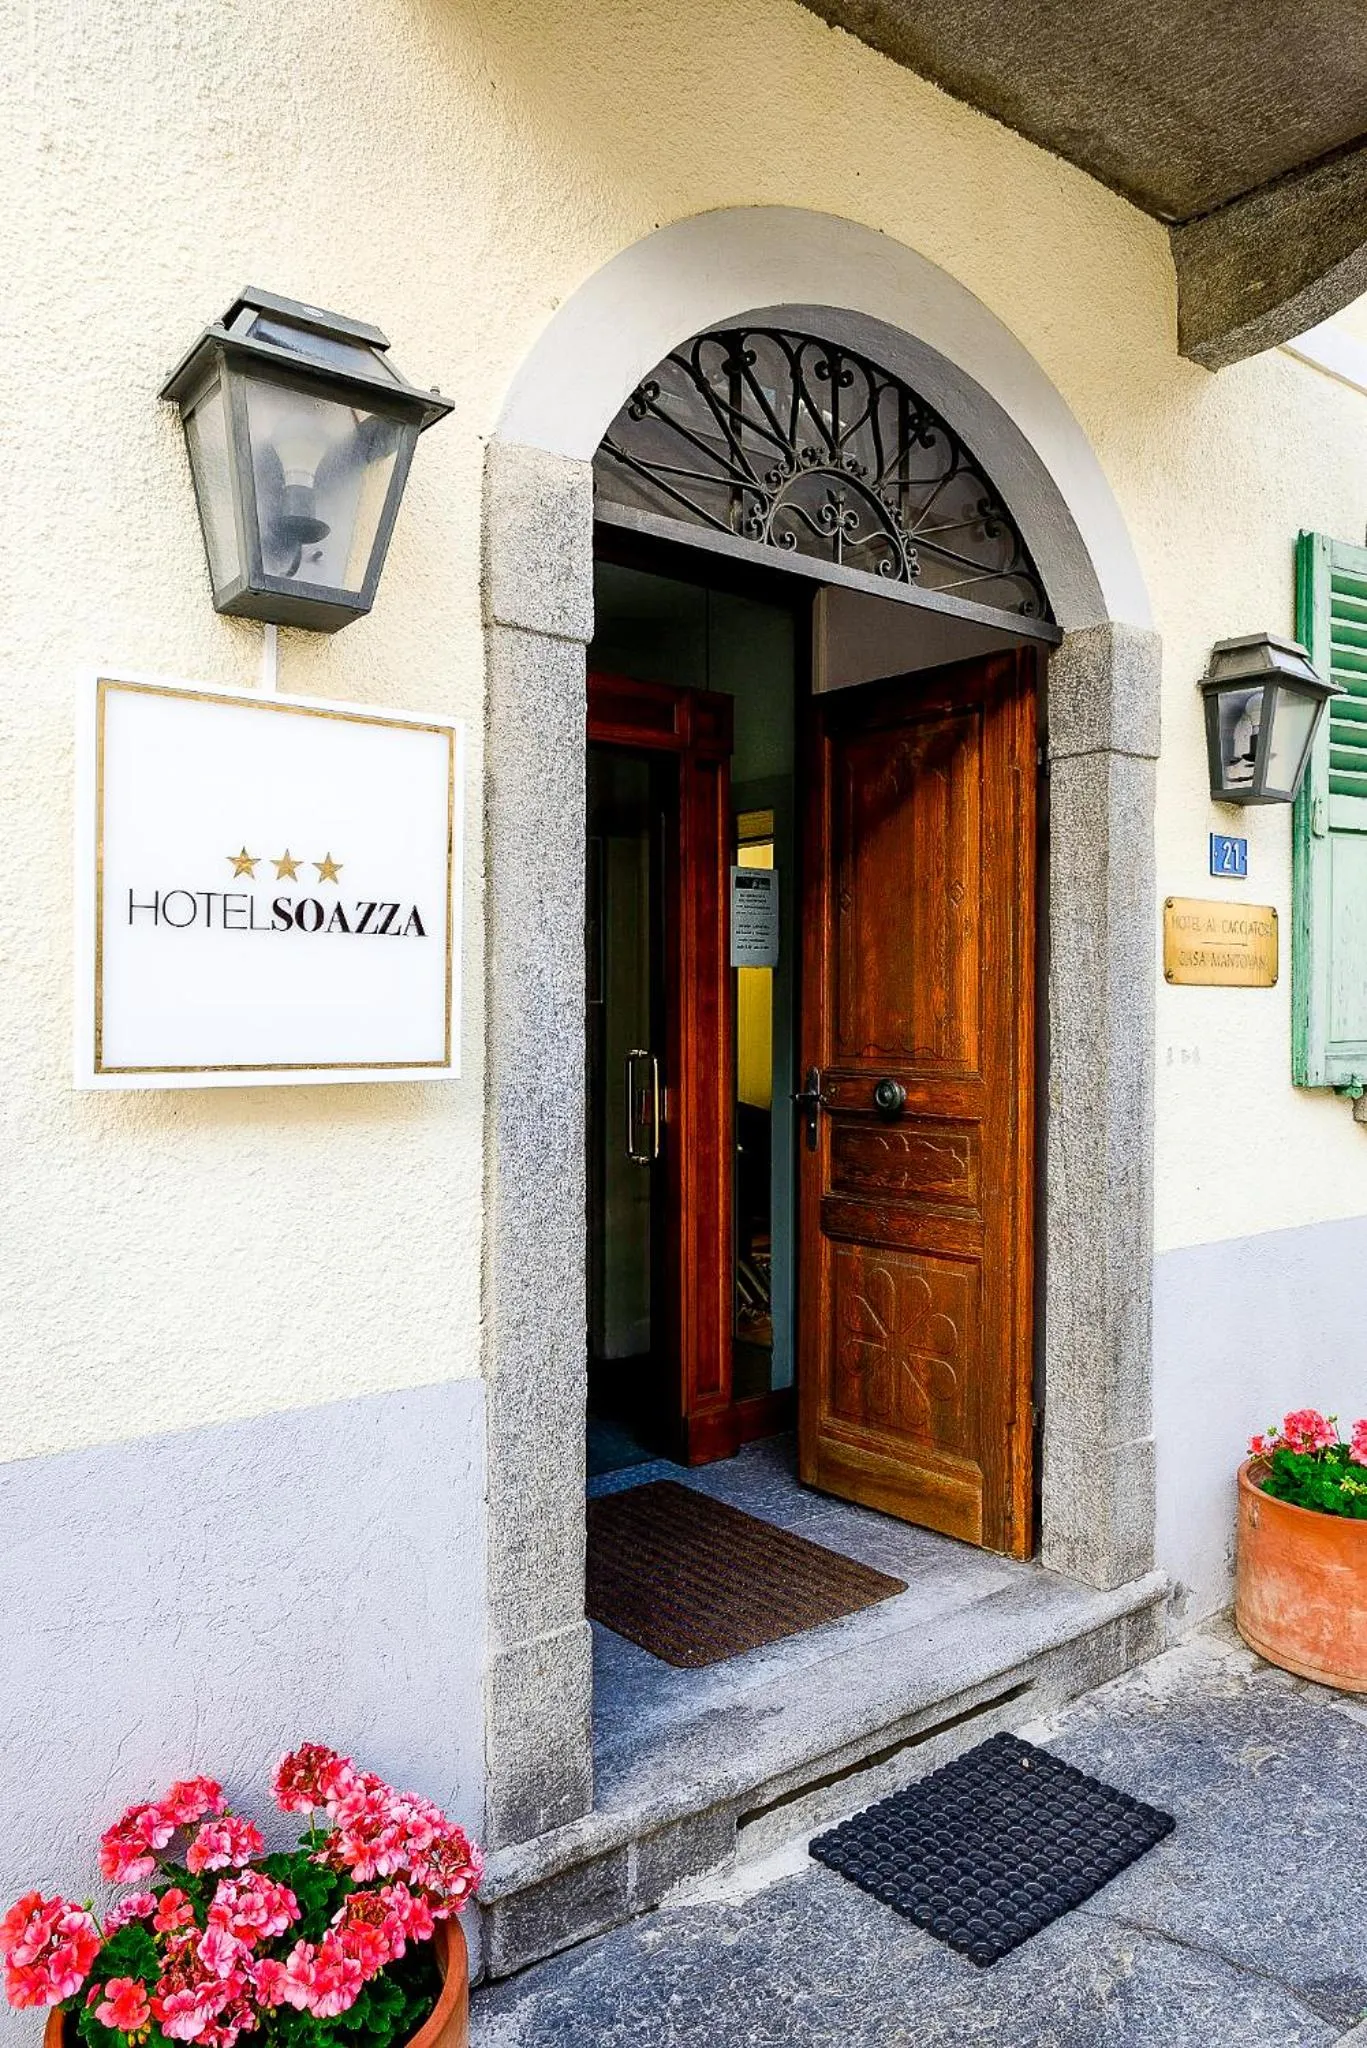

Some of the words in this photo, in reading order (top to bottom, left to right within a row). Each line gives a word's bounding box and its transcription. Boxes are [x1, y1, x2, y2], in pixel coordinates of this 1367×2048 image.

[1222, 841, 1240, 870] 21
[1171, 914, 1201, 932] HOTEL
[1178, 950, 1206, 968] CASA
